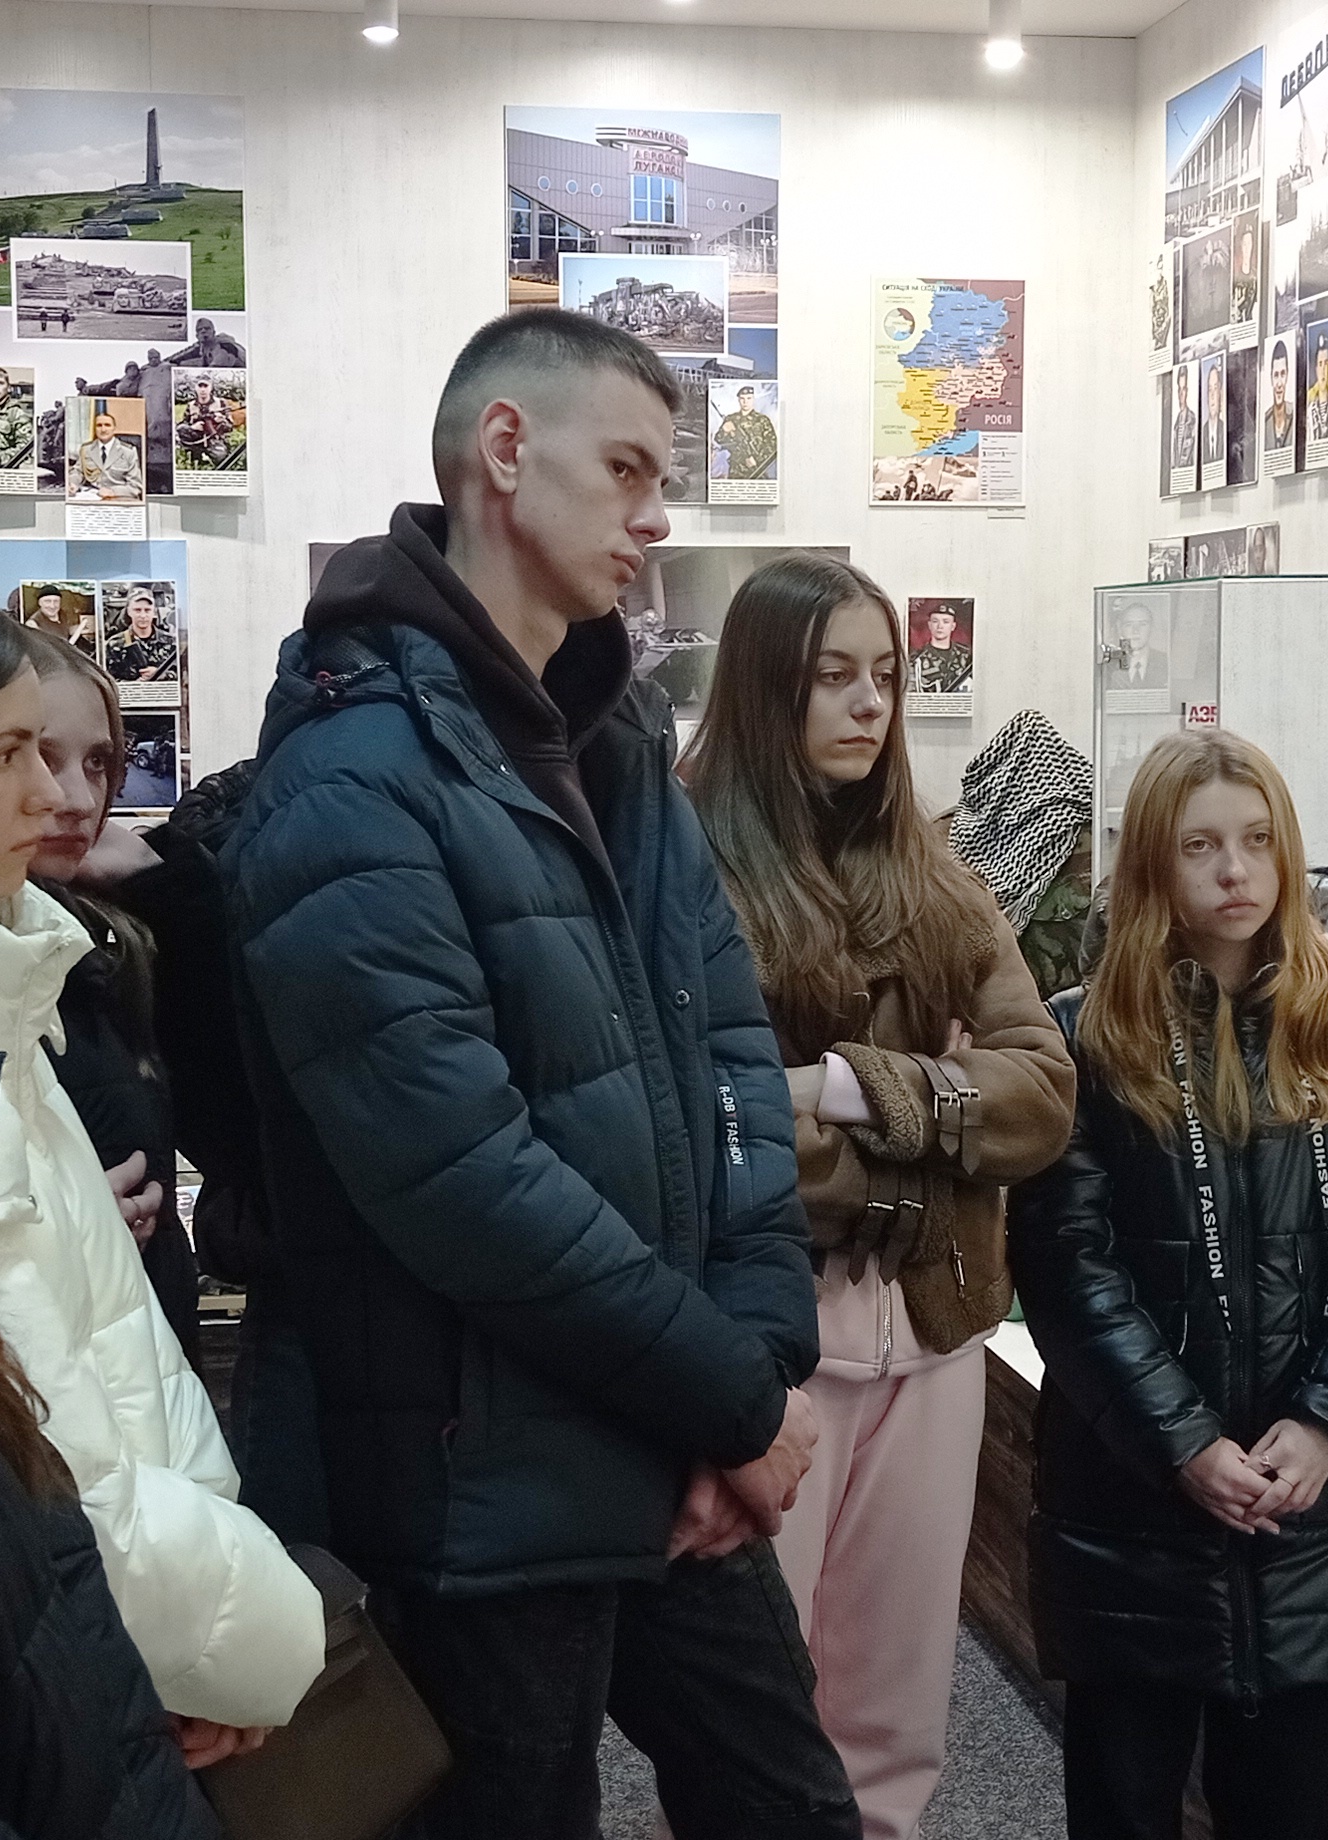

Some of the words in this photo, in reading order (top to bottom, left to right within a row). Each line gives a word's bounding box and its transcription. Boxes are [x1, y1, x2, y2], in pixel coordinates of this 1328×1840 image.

[984, 414, 1012, 425] РОСІЯ
[726, 1121, 744, 1165] FASHION
[1198, 1185, 1224, 1279] FASHION
